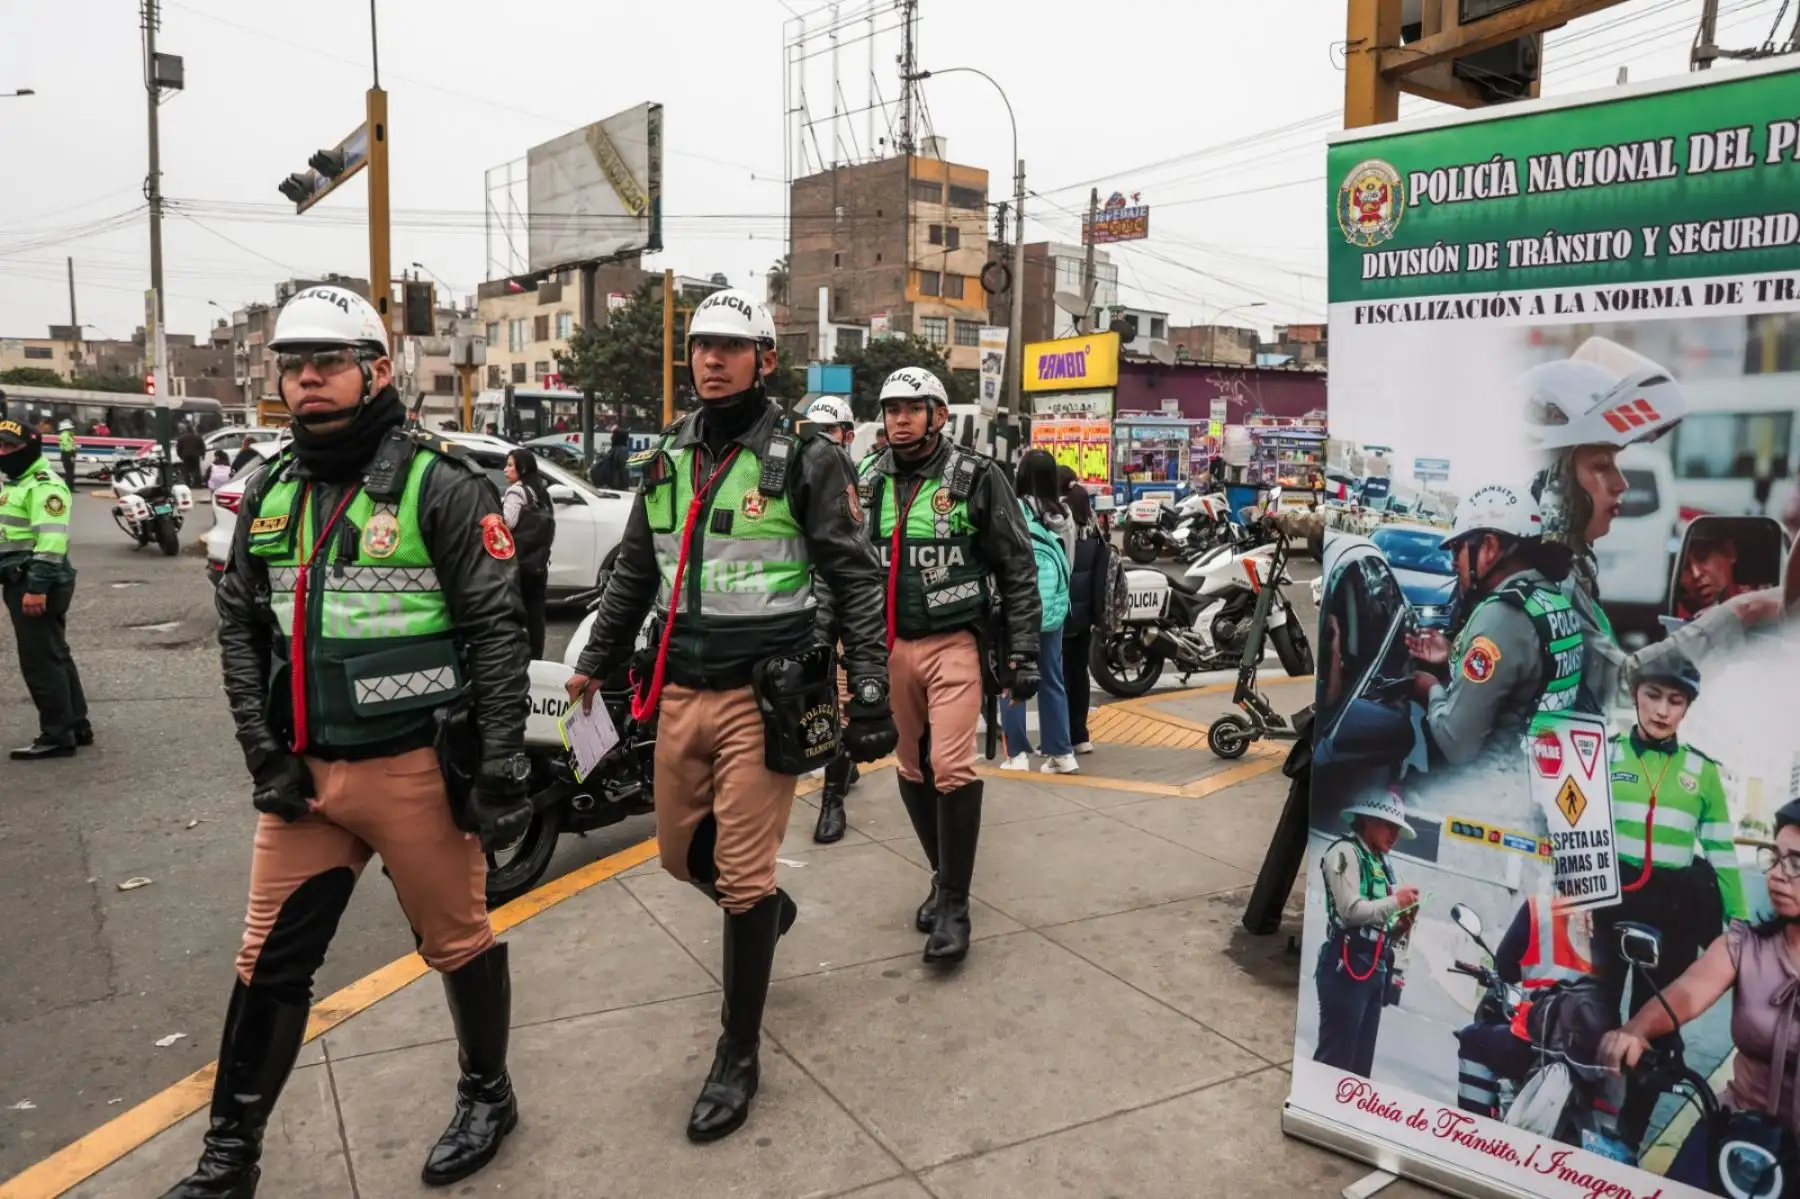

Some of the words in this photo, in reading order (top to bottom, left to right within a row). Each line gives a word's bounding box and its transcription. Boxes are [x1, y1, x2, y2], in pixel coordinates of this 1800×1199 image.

[1408, 154, 1520, 207] POLICÍA
[1527, 137, 1679, 194] NACIONAL
[1687, 126, 1756, 175] DEL
[1361, 240, 1460, 279] DIVISIÓN
[1466, 241, 1499, 271] DE
[1507, 228, 1633, 268] TRÁNSITO
[1641, 226, 1660, 257] Y
[1668, 212, 1800, 256] SEGURID
[287, 289, 349, 314] LICIA
[1355, 293, 1522, 325] FISCALIZACIÓN
[1529, 295, 1545, 315] A
[1554, 292, 1585, 314] LA
[1594, 285, 1693, 312] NORMA
[1704, 281, 1743, 306] DE
[1753, 277, 1800, 303] TR
[884, 373, 921, 391] OLICIA
[1128, 592, 1159, 608] OLICIA
[1590, 829, 1610, 848] LAS
[1553, 853, 1593, 876] ORMAS
[1597, 851, 1610, 870] DE
[1336, 1077, 1402, 1123] Policía
[1406, 1108, 1429, 1131] de
